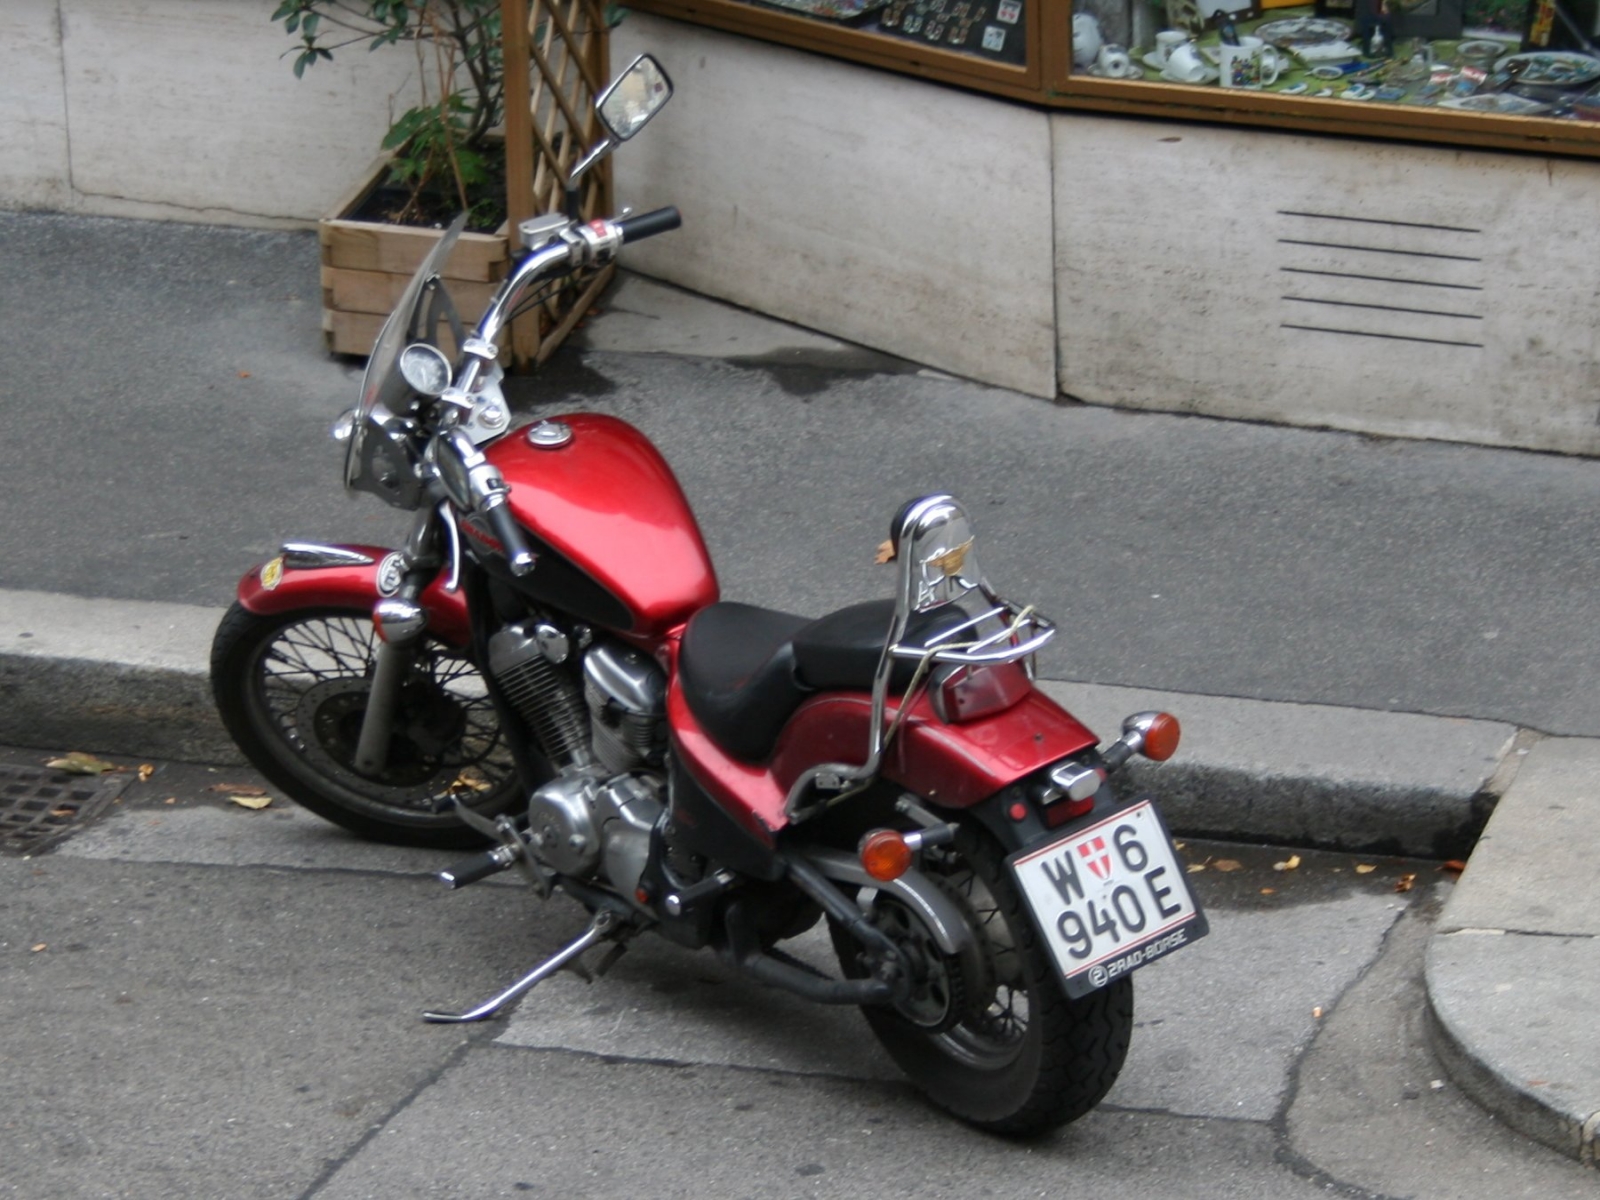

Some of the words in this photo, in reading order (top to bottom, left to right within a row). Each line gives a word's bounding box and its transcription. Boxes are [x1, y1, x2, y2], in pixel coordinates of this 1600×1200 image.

[1041, 850, 1085, 905] W
[1113, 824, 1148, 872] 6
[1057, 884, 1146, 960] 940
[1143, 865, 1182, 920] E
